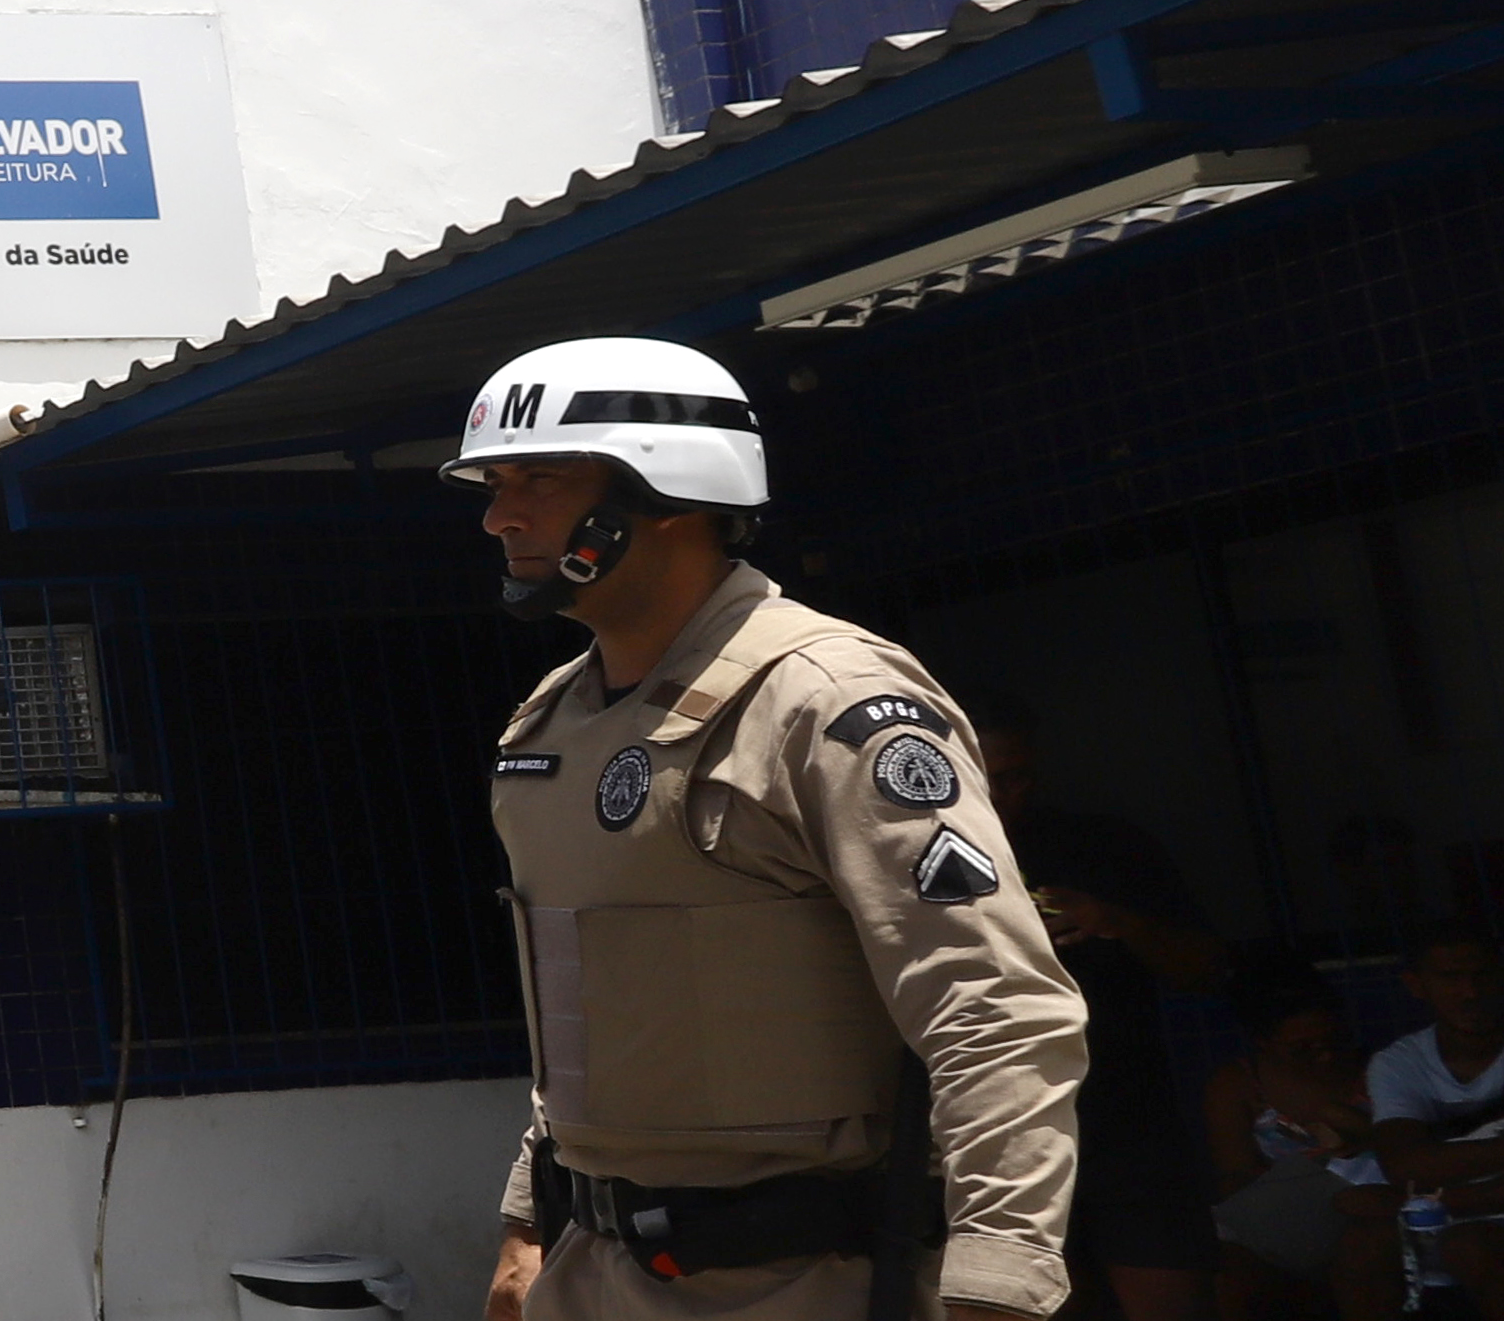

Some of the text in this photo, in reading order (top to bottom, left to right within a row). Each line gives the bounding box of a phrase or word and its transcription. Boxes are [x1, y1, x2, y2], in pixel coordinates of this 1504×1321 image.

[5, 244, 39, 266] da
[46, 243, 129, 265] Saúde
[498, 382, 547, 430] M
